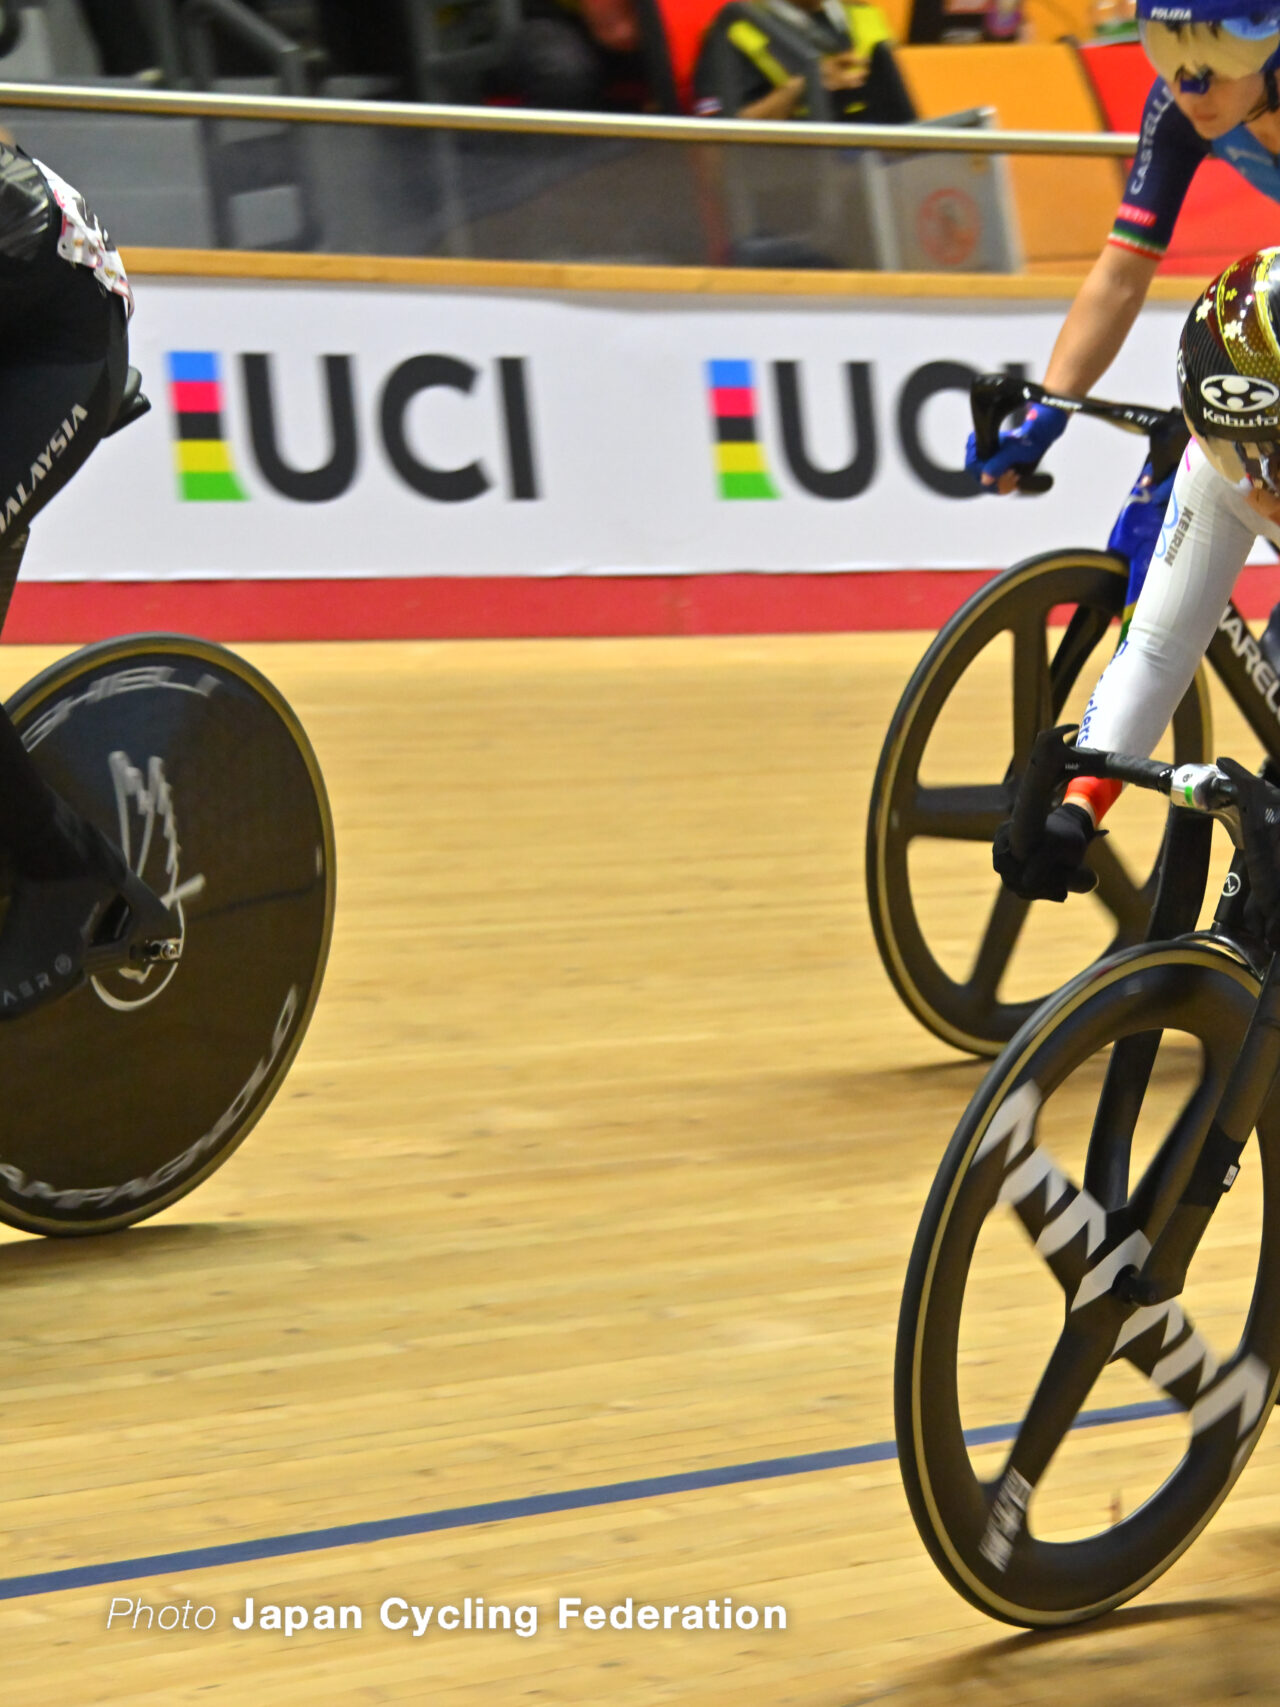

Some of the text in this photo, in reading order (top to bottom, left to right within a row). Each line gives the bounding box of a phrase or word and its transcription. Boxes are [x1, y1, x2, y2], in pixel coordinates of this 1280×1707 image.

[1151, 6, 1192, 21] POLIZIA
[1130, 86, 1175, 195] CASTELL
[0, 403, 89, 534] ALAYSIA
[238, 351, 542, 504] UCI
[768, 359, 1034, 501] UC
[1202, 407, 1279, 427] Kabuto
[1163, 505, 1195, 568] KEIRIN
